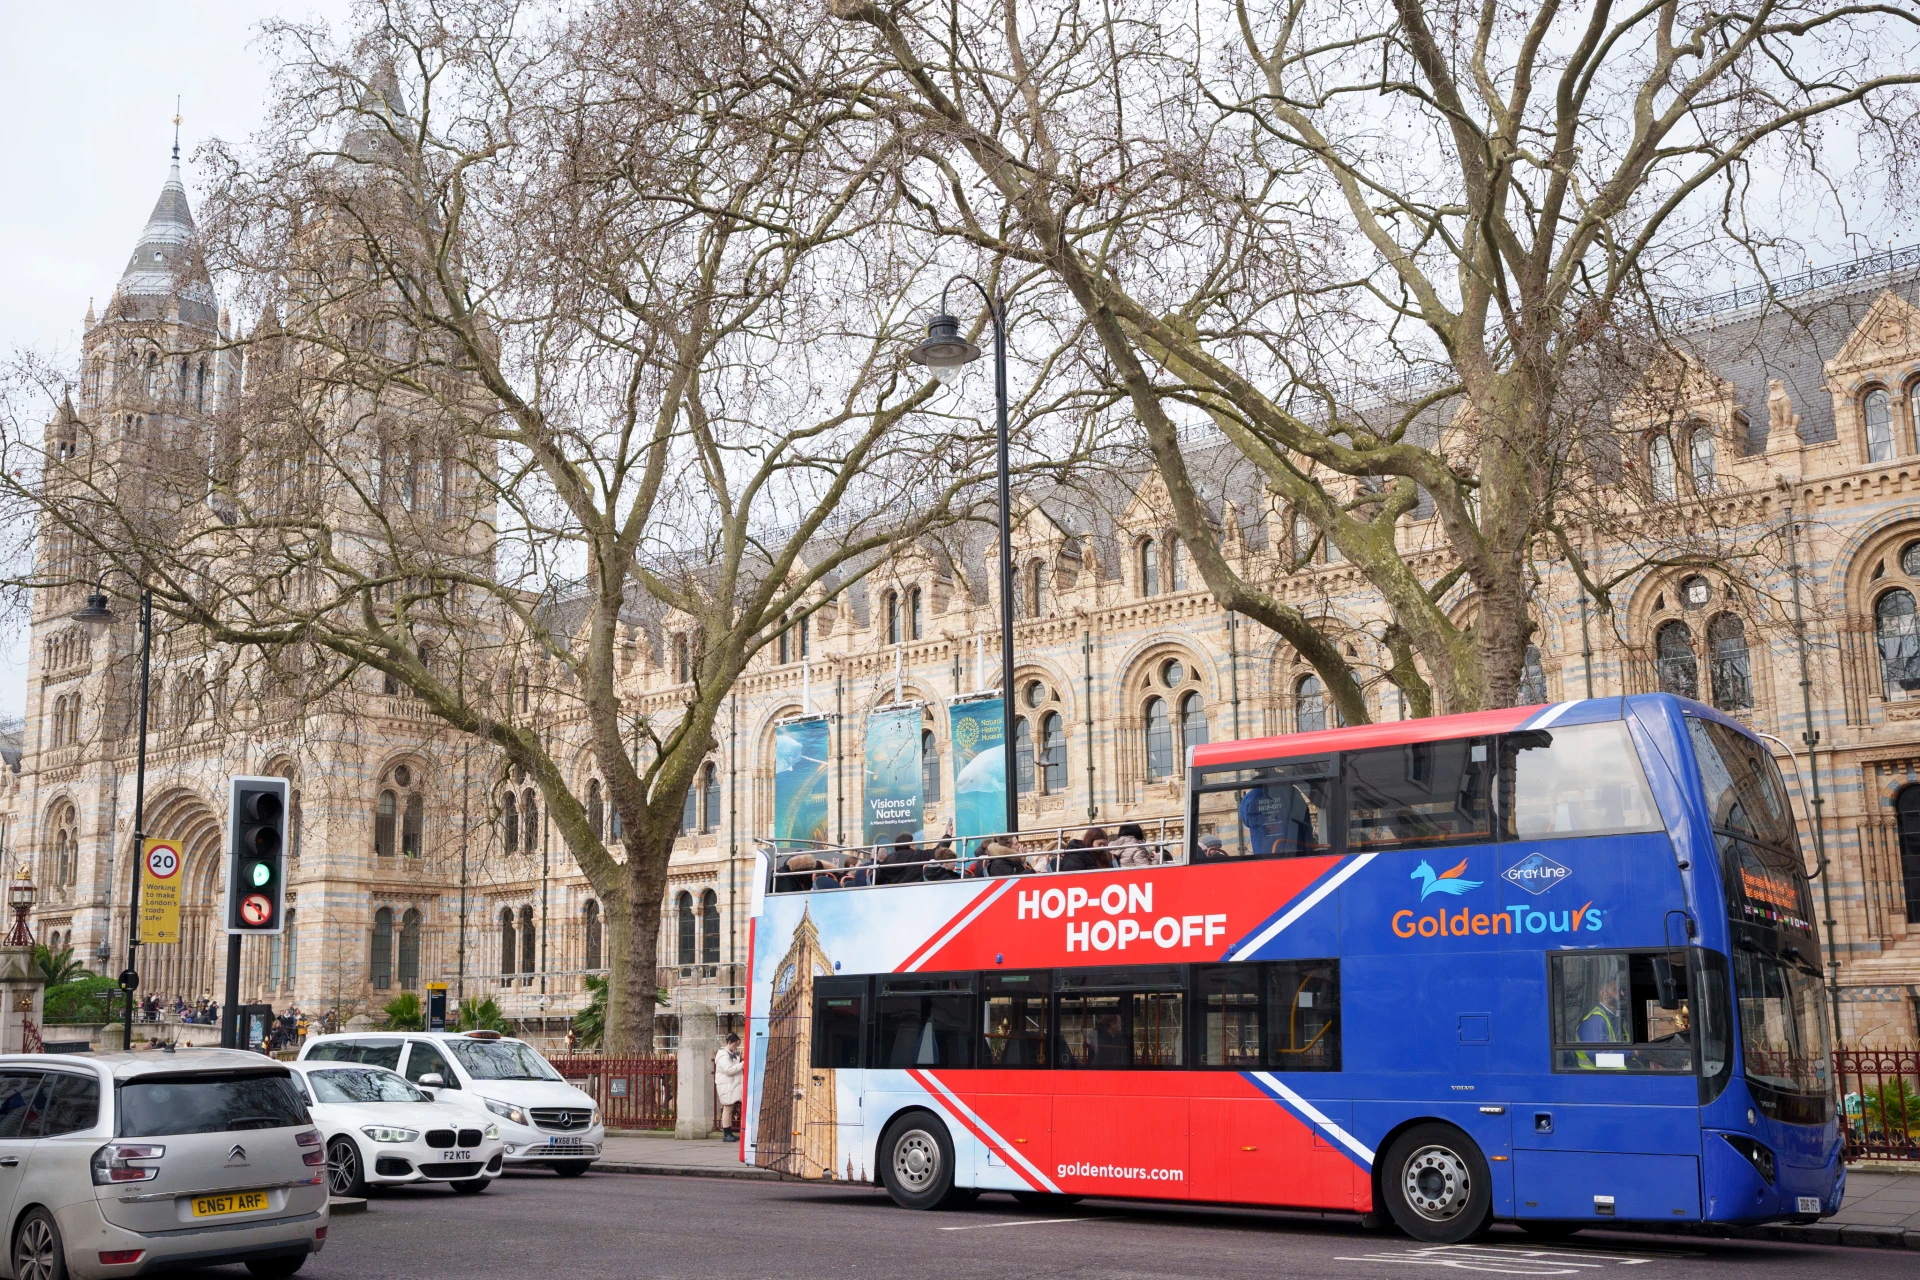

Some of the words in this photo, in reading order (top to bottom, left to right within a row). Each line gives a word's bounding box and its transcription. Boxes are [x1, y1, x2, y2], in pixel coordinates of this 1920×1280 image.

[981, 717, 1002, 726] Natural
[870, 799, 905, 809] Visions
[906, 796, 916, 806] of
[1258, 803, 1283, 811] HOP-OFF
[876, 809, 910, 819] Nature
[152, 855, 174, 868] 20
[146, 884, 176, 892] Working
[1018, 882, 1153, 920] HOP-ON
[1066, 914, 1227, 952] HOP-OFF
[443, 1151, 454, 1160] F2
[455, 1150, 471, 1159] KTG
[1057, 1161, 1184, 1181] goldentours.com
[197, 1197, 234, 1214] CN67
[238, 1193, 262, 1209] ARF
